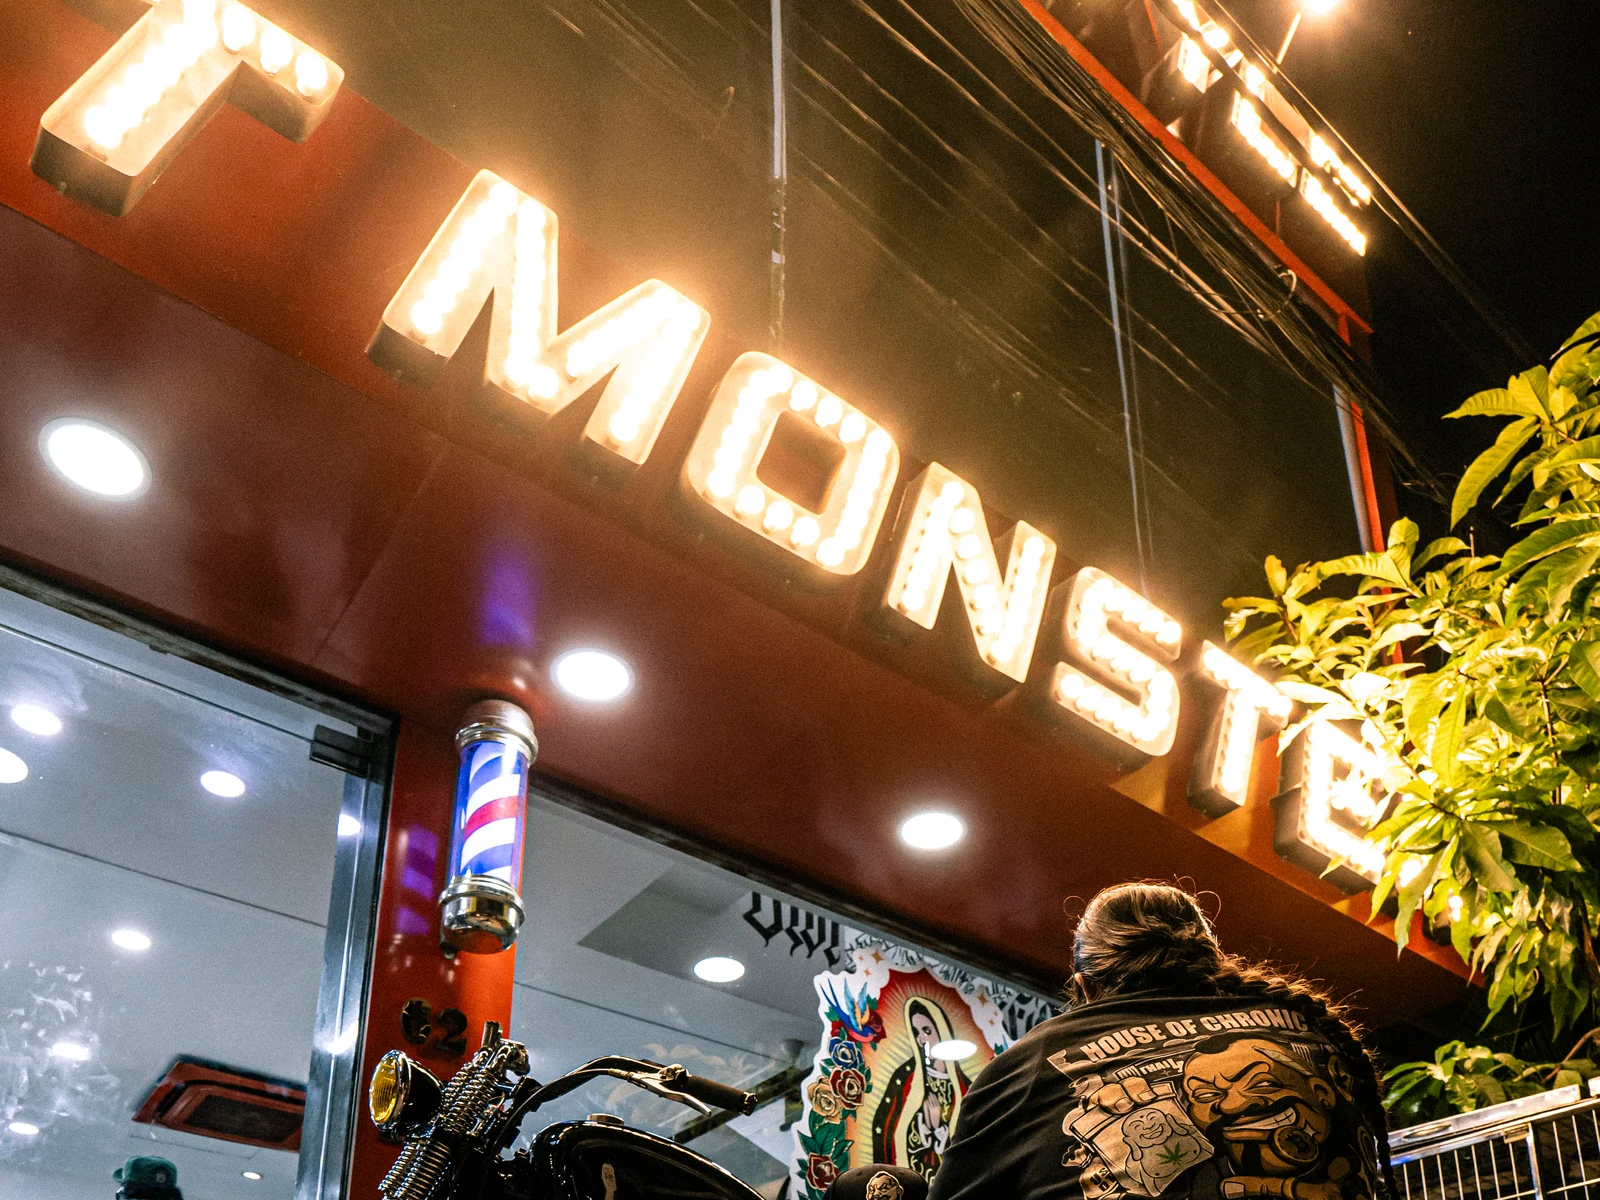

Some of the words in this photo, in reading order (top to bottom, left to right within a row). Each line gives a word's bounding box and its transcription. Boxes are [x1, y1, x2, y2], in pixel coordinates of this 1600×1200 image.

[370, 168, 1462, 925] MONSTE
[1080, 1024, 1167, 1061] HOUSE
[1164, 1019, 1198, 1037] OF
[1200, 1009, 1308, 1032] CHRONIC
